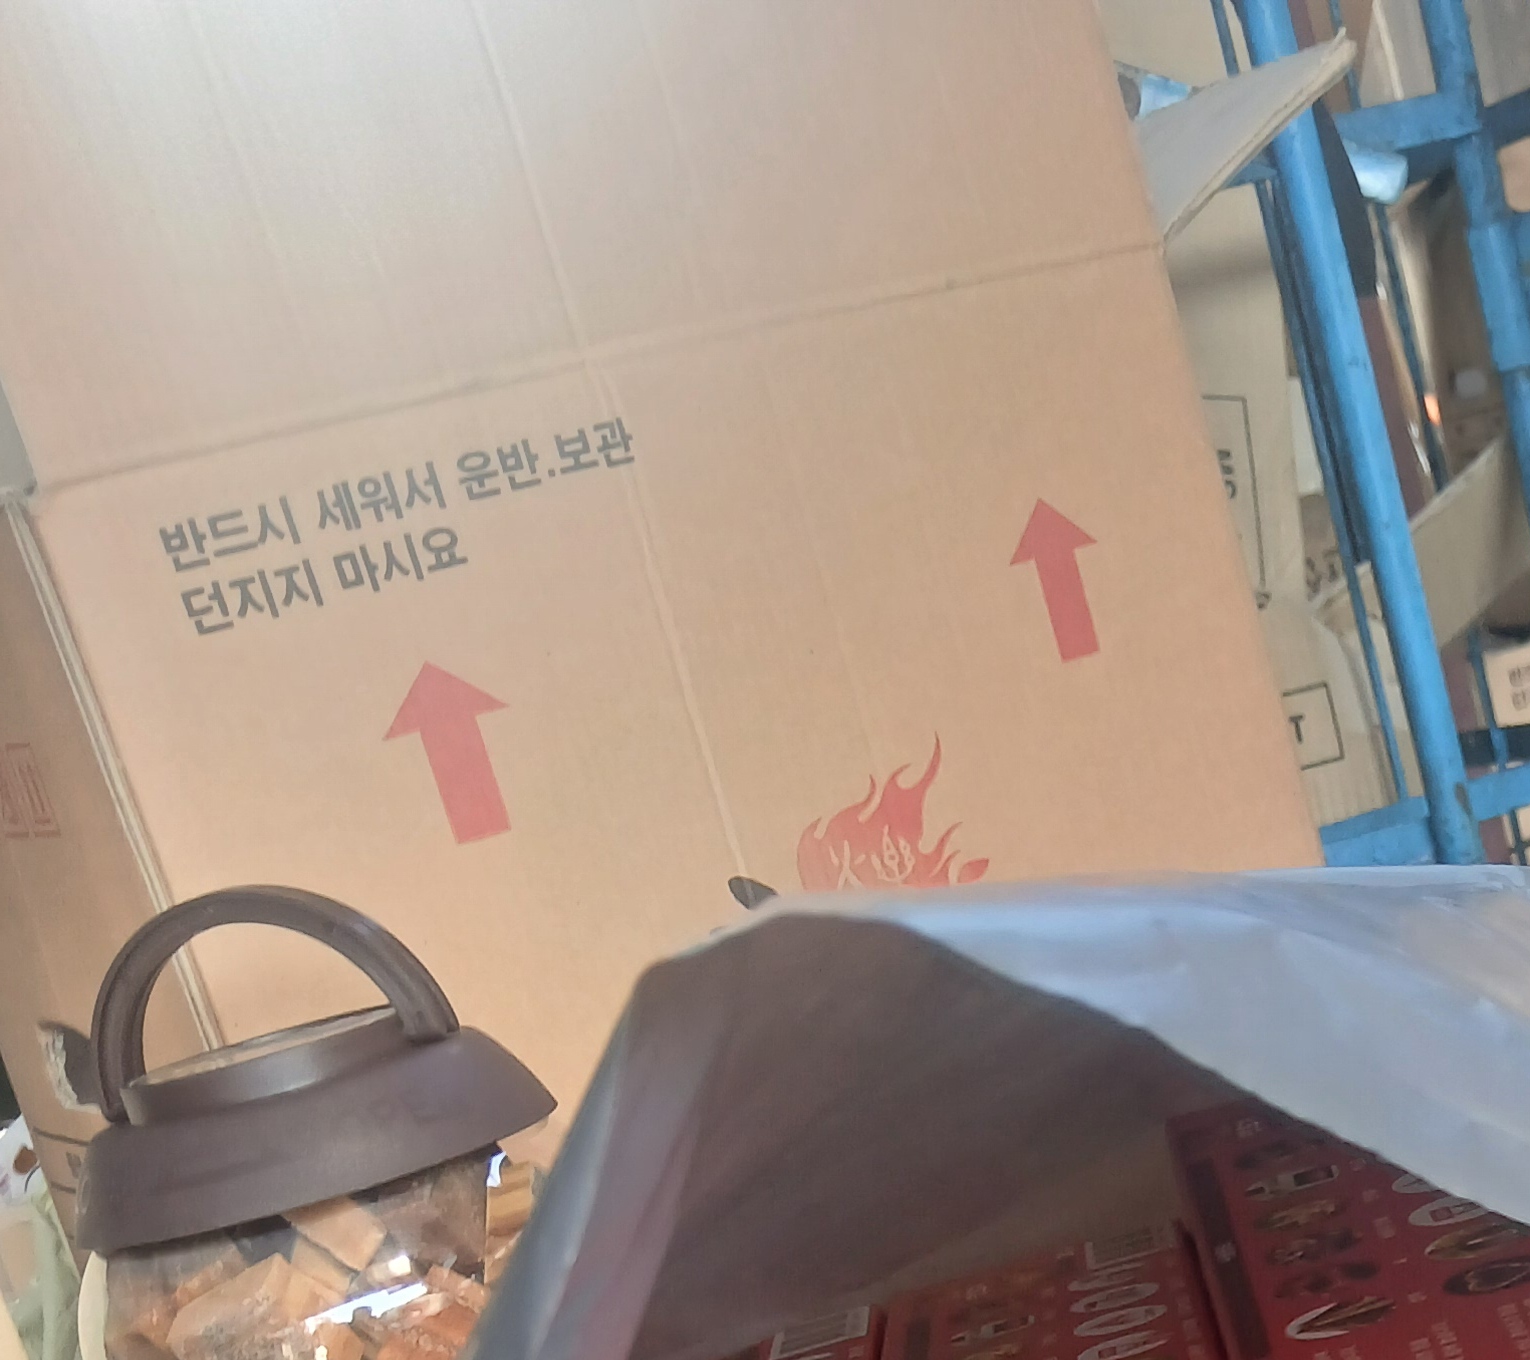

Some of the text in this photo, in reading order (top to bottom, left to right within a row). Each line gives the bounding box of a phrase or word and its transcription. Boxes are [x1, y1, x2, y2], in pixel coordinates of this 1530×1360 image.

[160, 415, 637, 573] 반드시 세워서 운반.보관
[181, 525, 468, 635] 던지지 마시요
